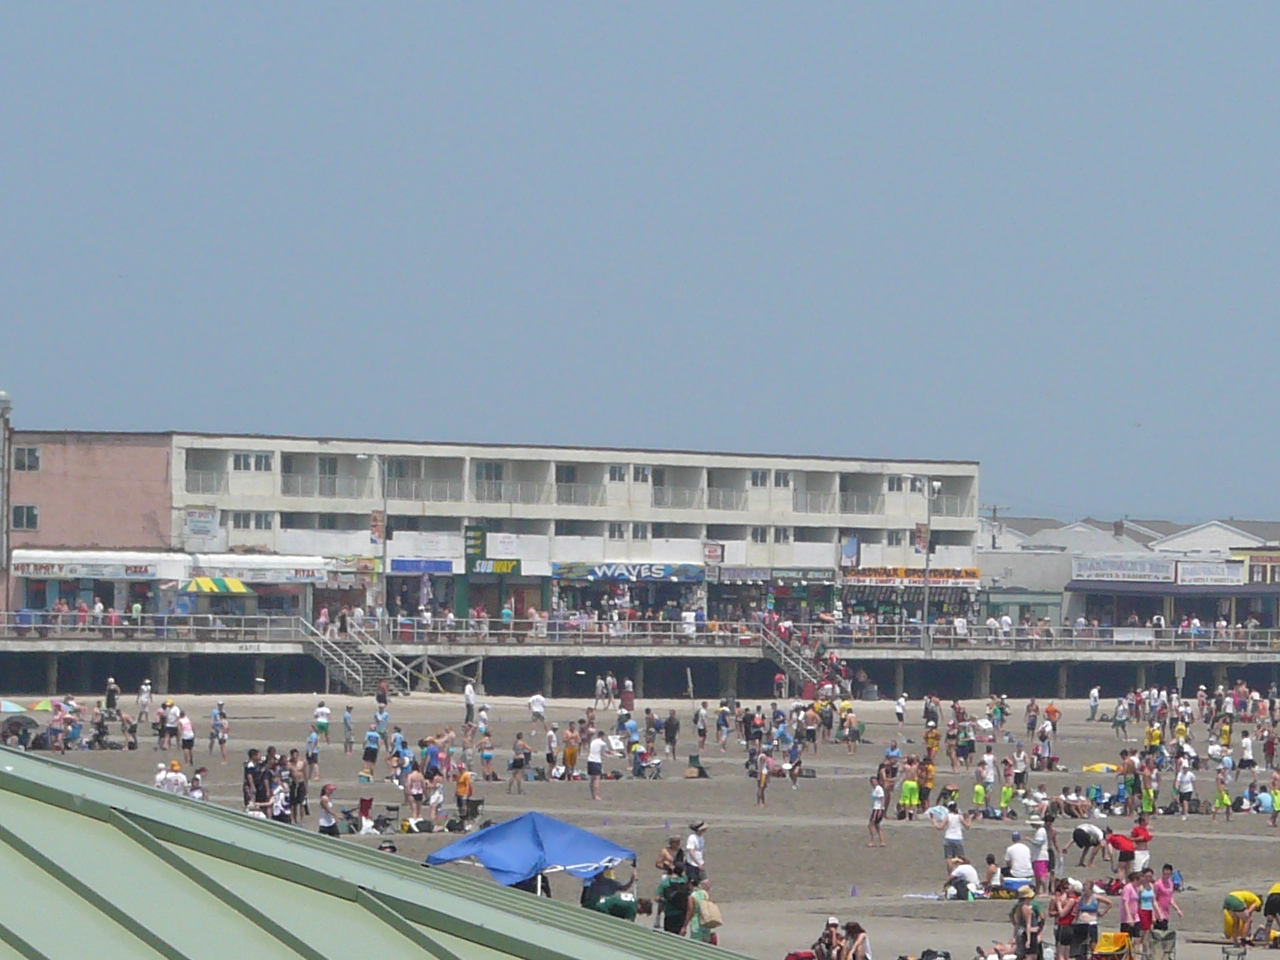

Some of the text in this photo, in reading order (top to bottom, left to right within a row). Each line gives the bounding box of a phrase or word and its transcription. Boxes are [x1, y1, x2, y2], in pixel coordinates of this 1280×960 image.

[125, 565, 149, 574] PIZZA
[472, 559, 517, 573] SUBWAY
[594, 564, 665, 578] WAVES
